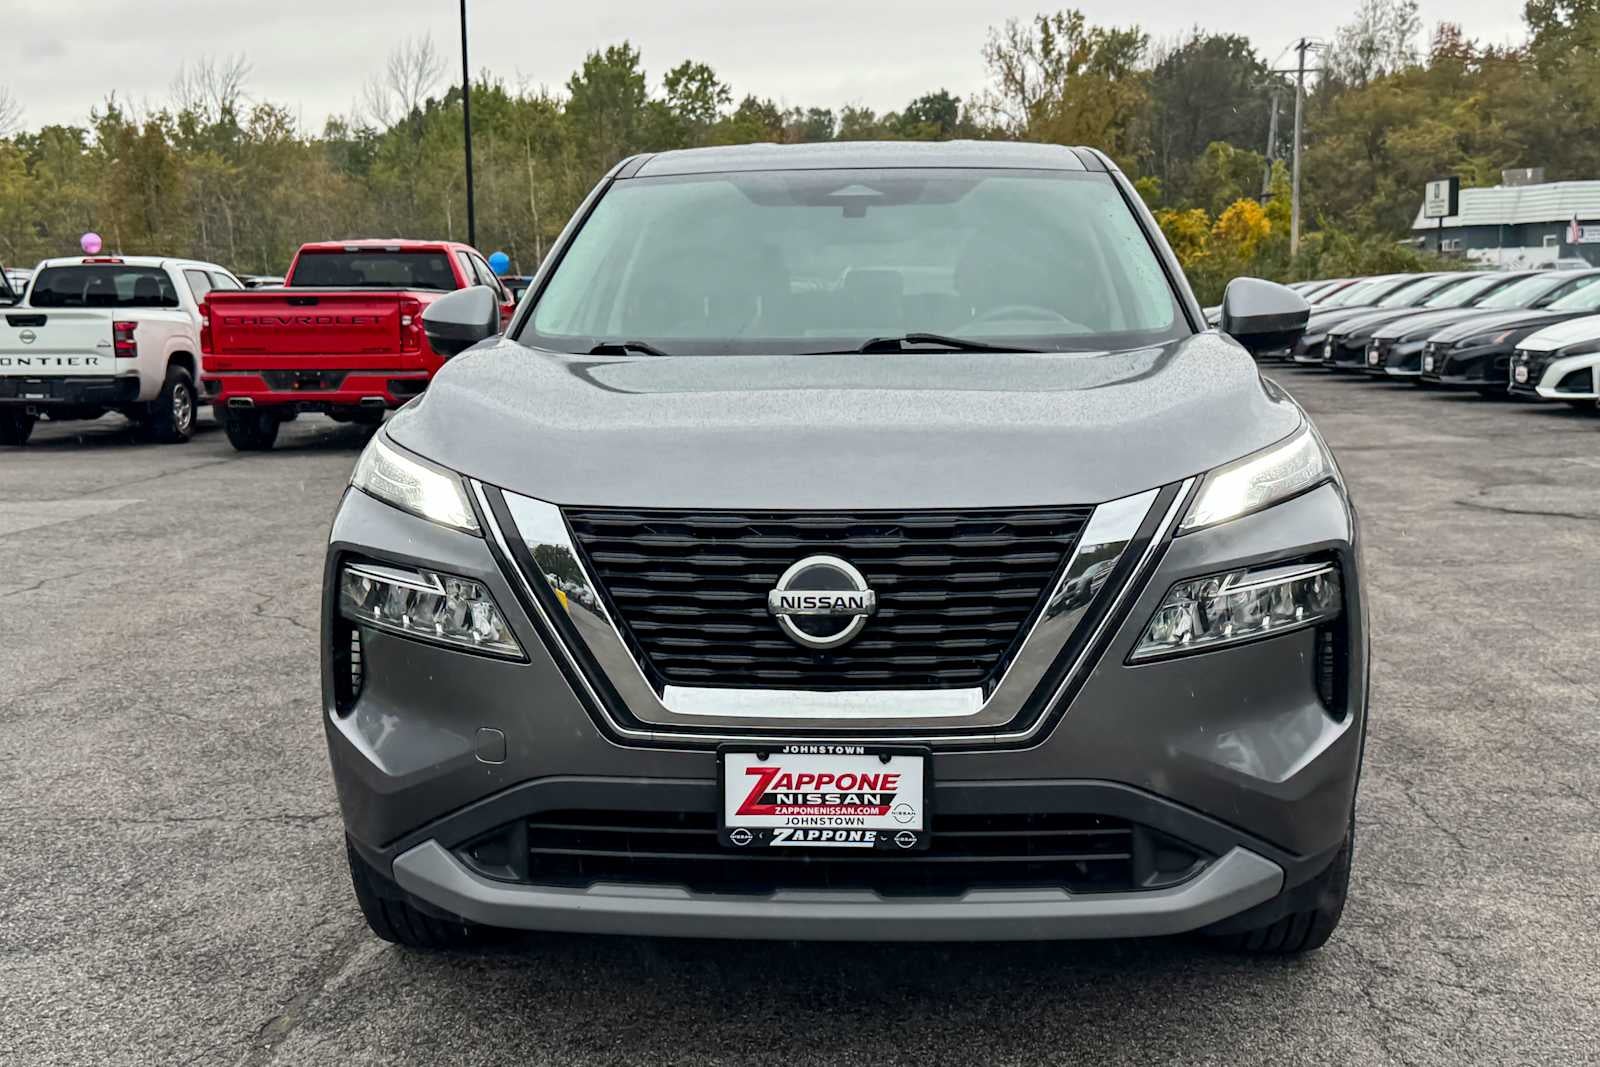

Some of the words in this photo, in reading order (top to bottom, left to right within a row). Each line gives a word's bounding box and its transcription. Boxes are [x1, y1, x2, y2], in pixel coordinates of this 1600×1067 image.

[223, 316, 382, 327] CHEVROLET
[780, 596, 864, 609] NISSAN
[782, 745, 865, 755] JOHNSTOWN
[735, 767, 901, 816] ZAPPONE
[776, 793, 881, 805] NISSAN
[774, 806, 880, 815] ZAPPONENISSAN.COM
[785, 817, 865, 826] JOHNSTOWN
[769, 829, 877, 848] ZAPPONE
